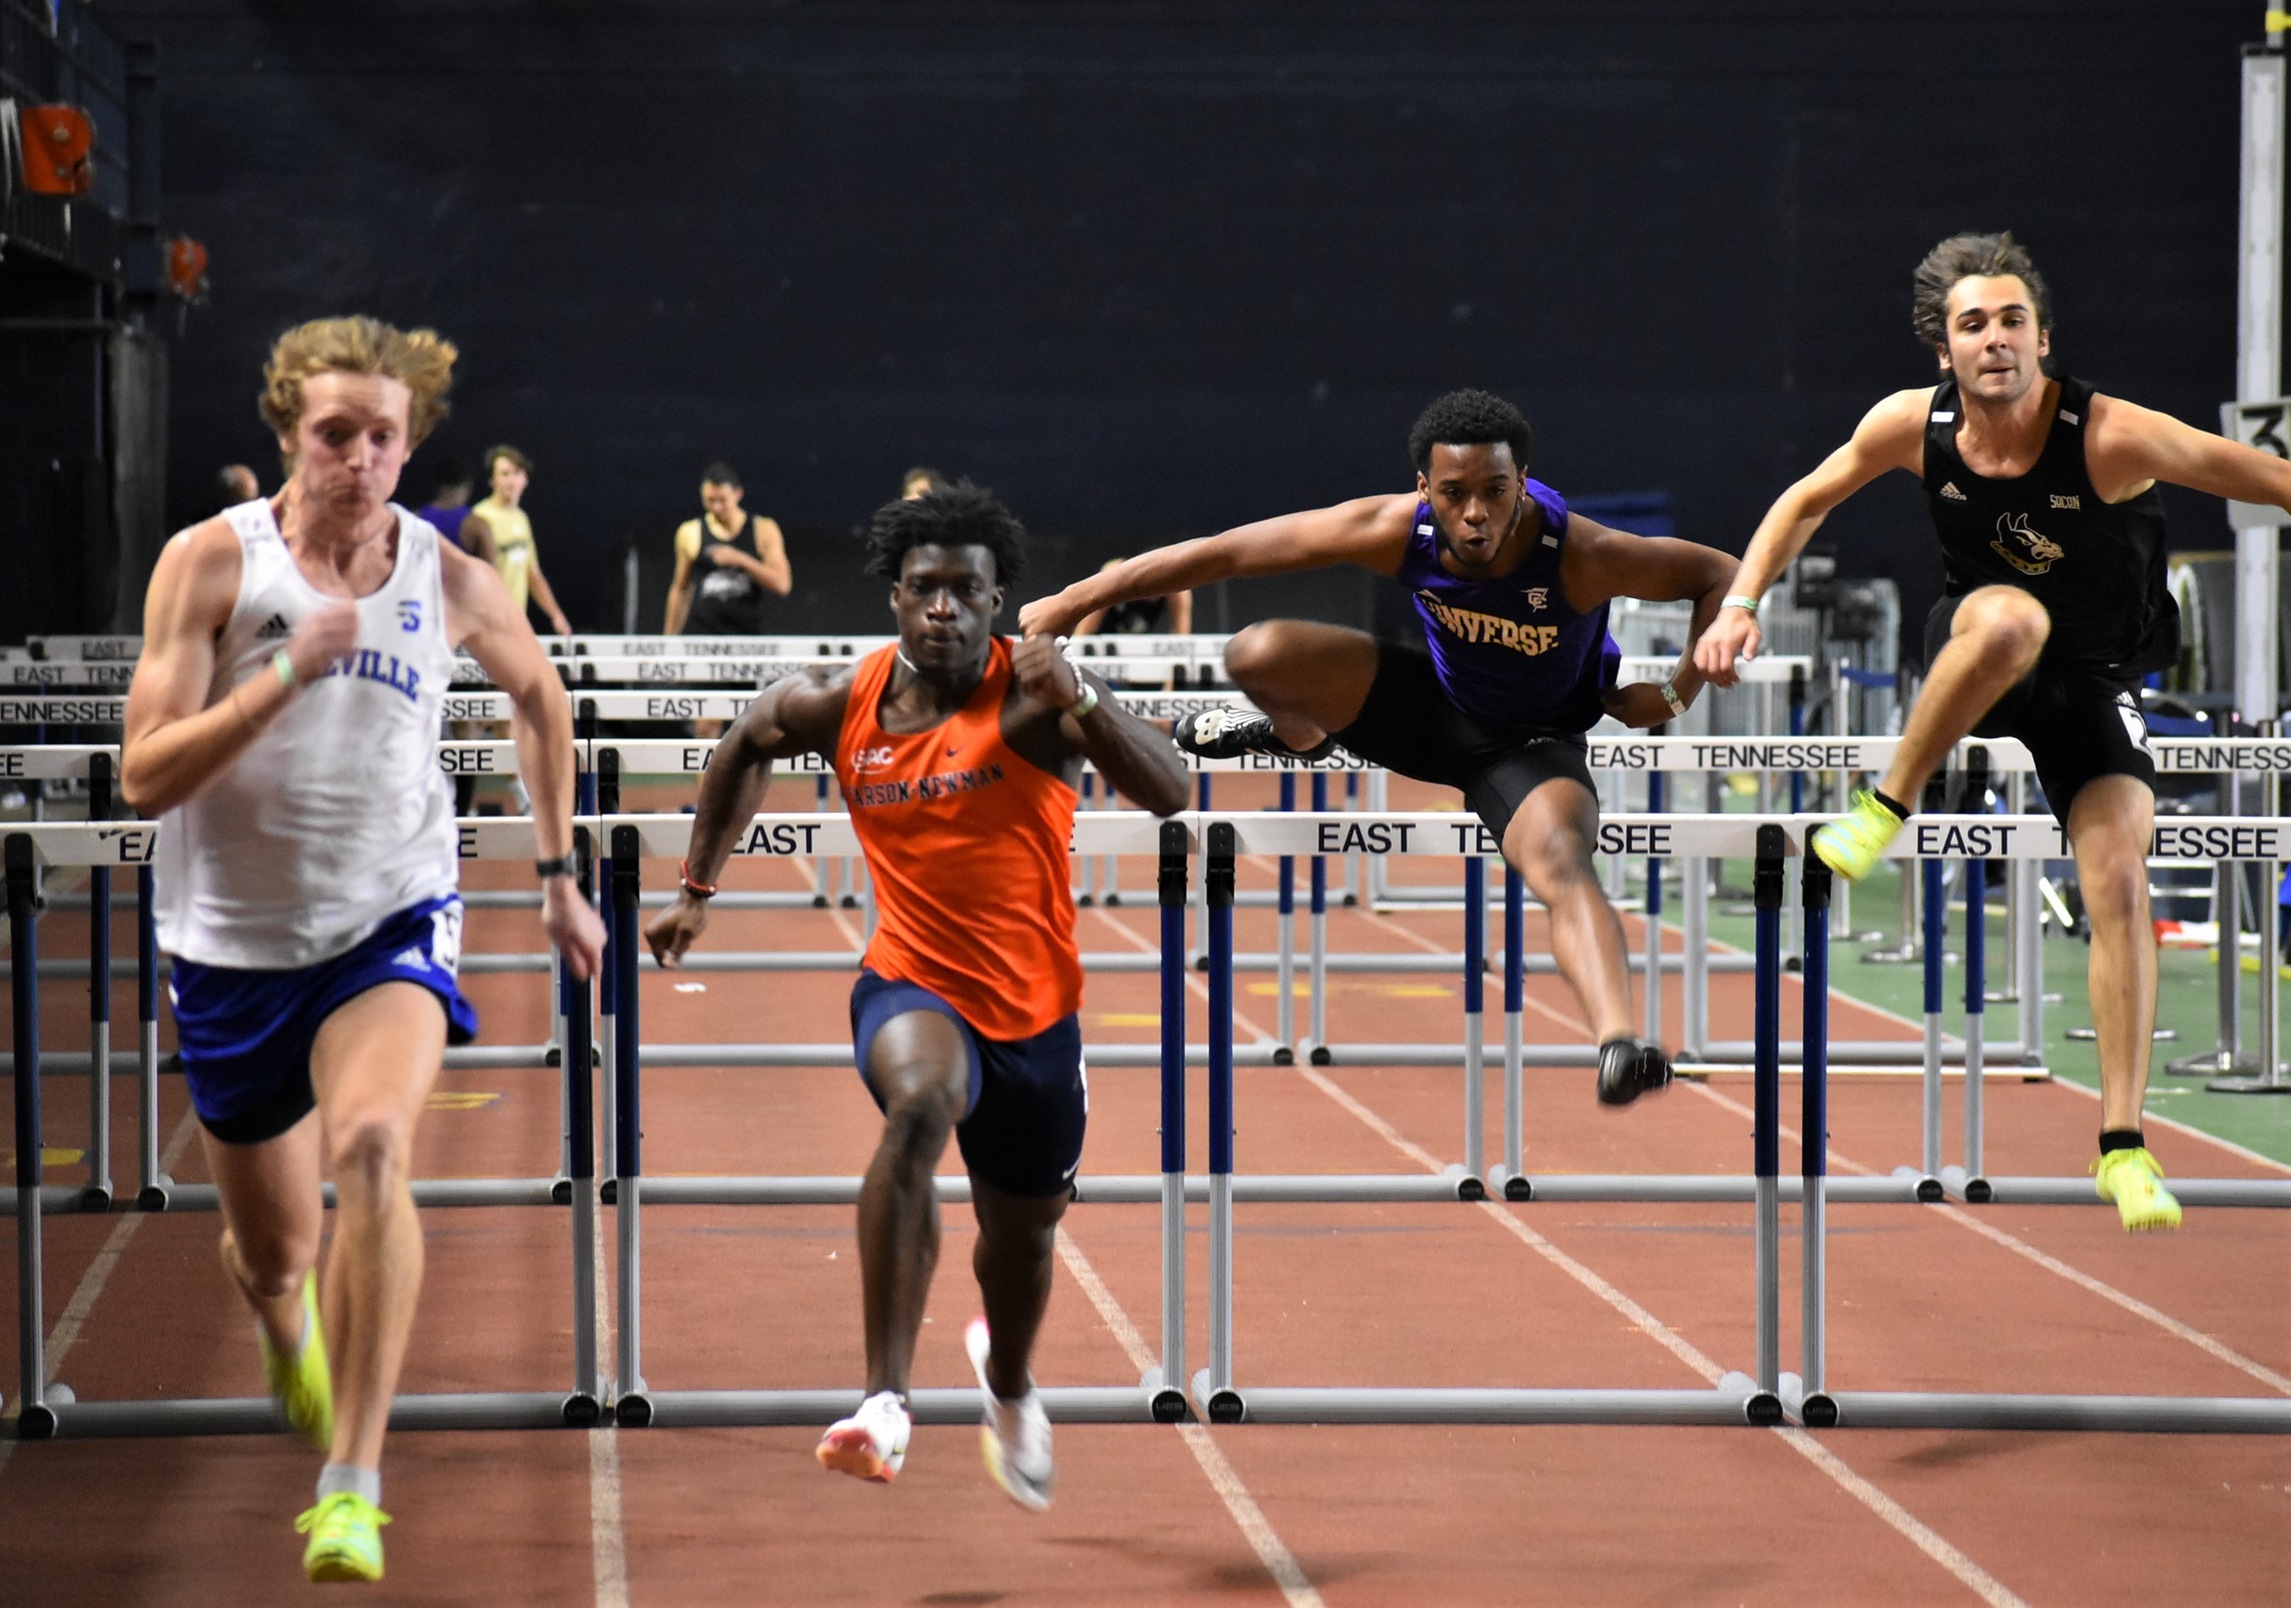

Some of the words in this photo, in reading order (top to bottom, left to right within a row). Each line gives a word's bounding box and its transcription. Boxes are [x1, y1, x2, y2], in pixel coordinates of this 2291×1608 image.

[2050, 494, 2080, 510] SOCON
[13, 666, 66, 682] EAST
[637, 663, 688, 679] EAST
[647, 699, 708, 717] EAST
[1589, 745, 1665, 768] EAST
[1692, 744, 1861, 769] TENNESSEE
[848, 763, 1004, 807] ARSON-NEWMAN
[1317, 823, 1416, 853] EAST
[1450, 823, 1672, 855] TESEE
[1917, 825, 2017, 857] EAST
[2052, 826, 2279, 859] TESSEE
